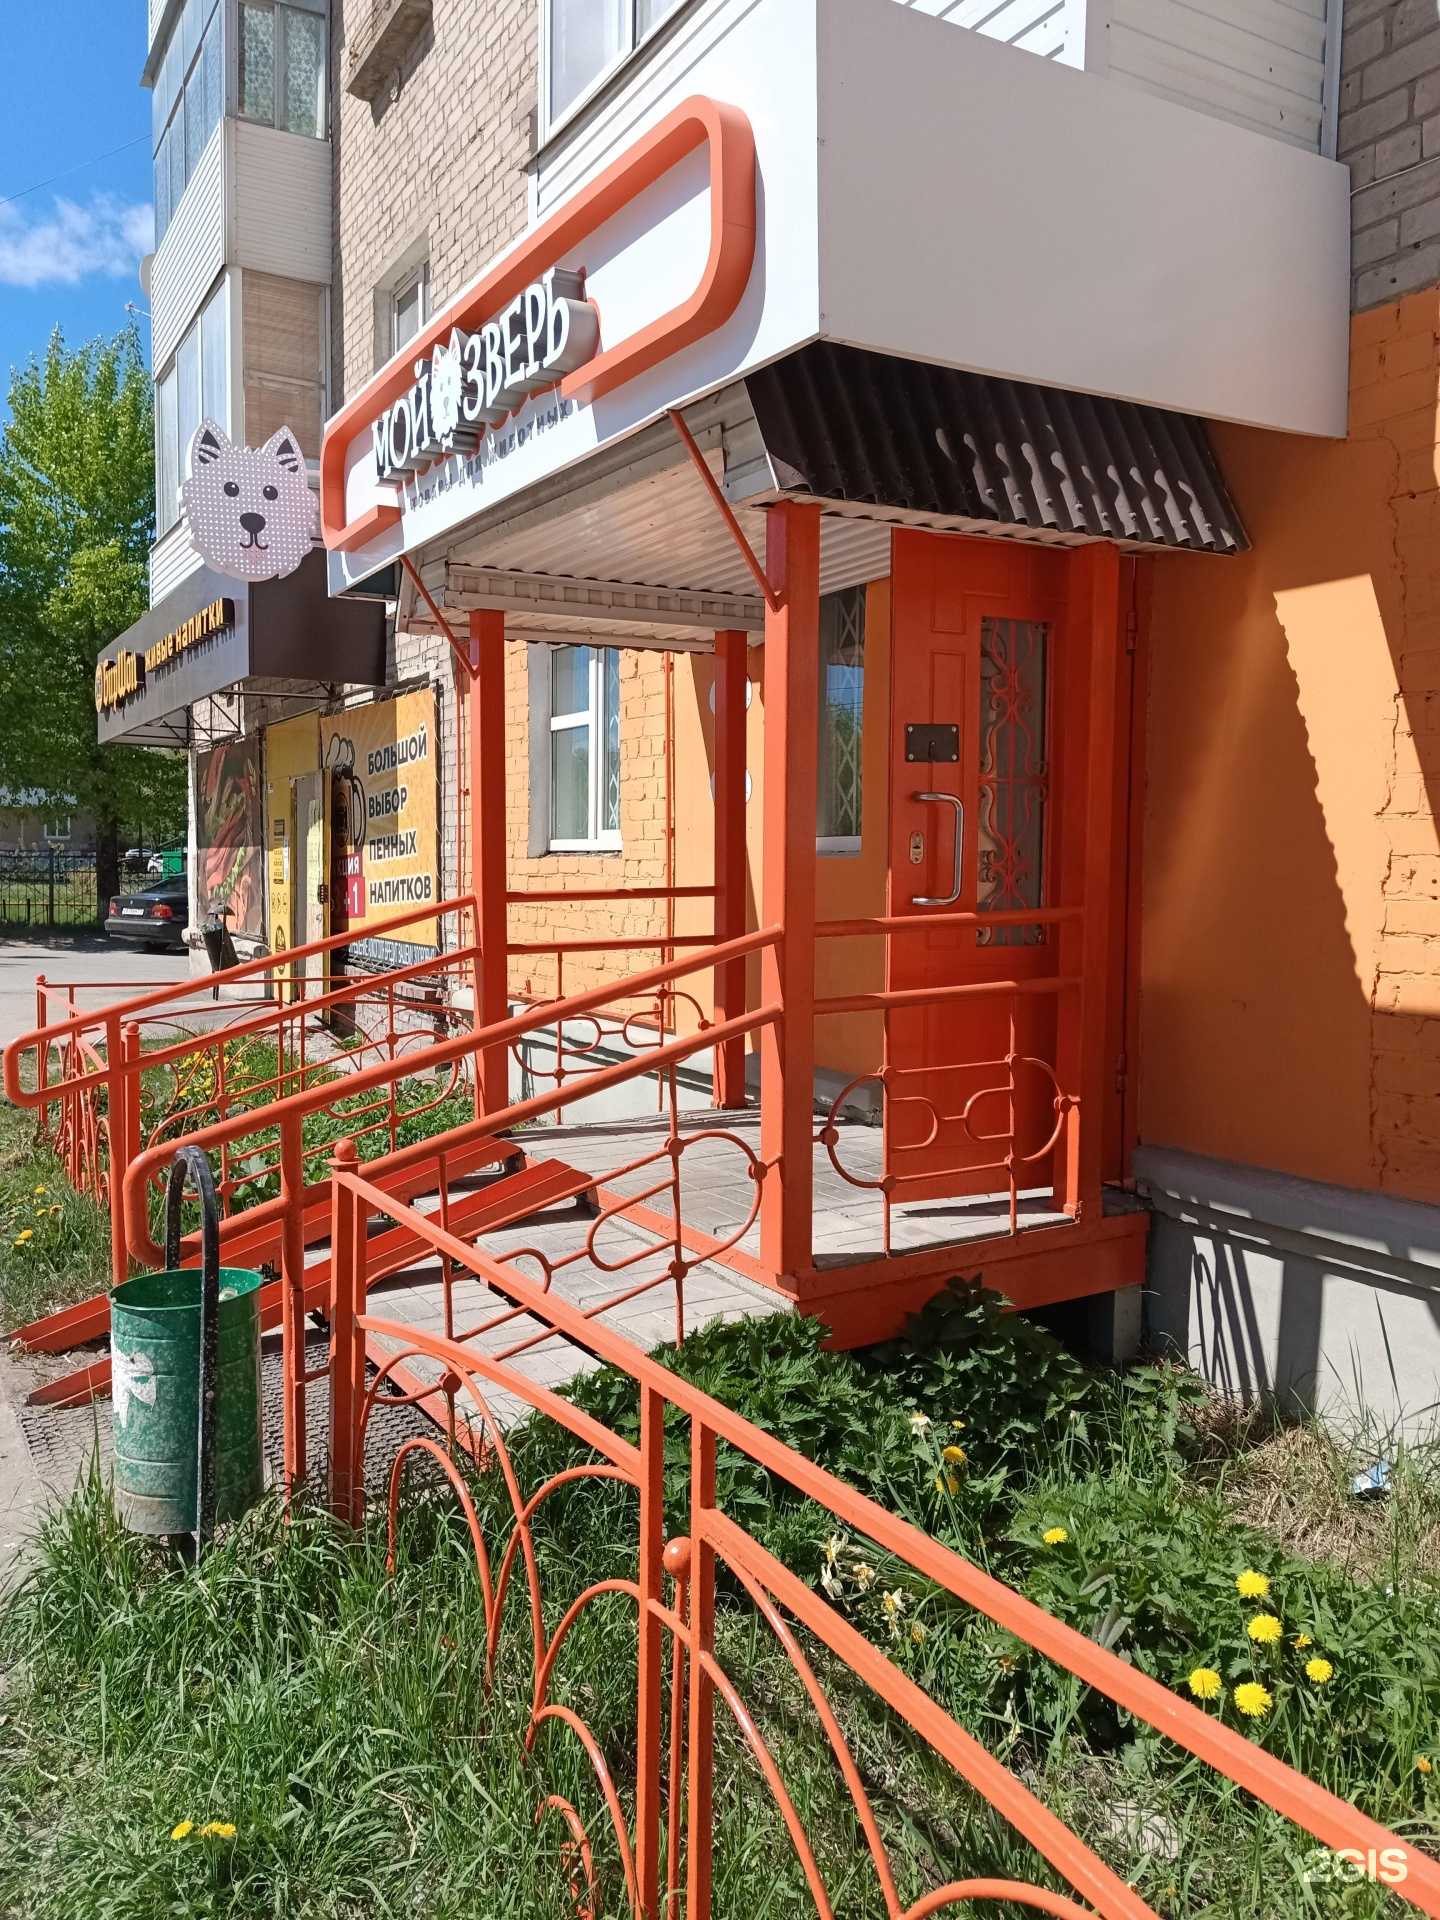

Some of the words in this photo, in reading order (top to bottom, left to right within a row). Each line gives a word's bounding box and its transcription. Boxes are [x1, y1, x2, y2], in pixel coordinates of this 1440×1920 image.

[372, 359, 431, 477] МОЙ
[462, 267, 570, 421] ЗВЕРЬ
[367, 725, 428, 775] БОЛЬШОЙ
[368, 787, 408, 818] ВЫБОР
[369, 830, 417, 861] ПЕННЫХ
[369, 875, 432, 904] НАПИТКОВ
